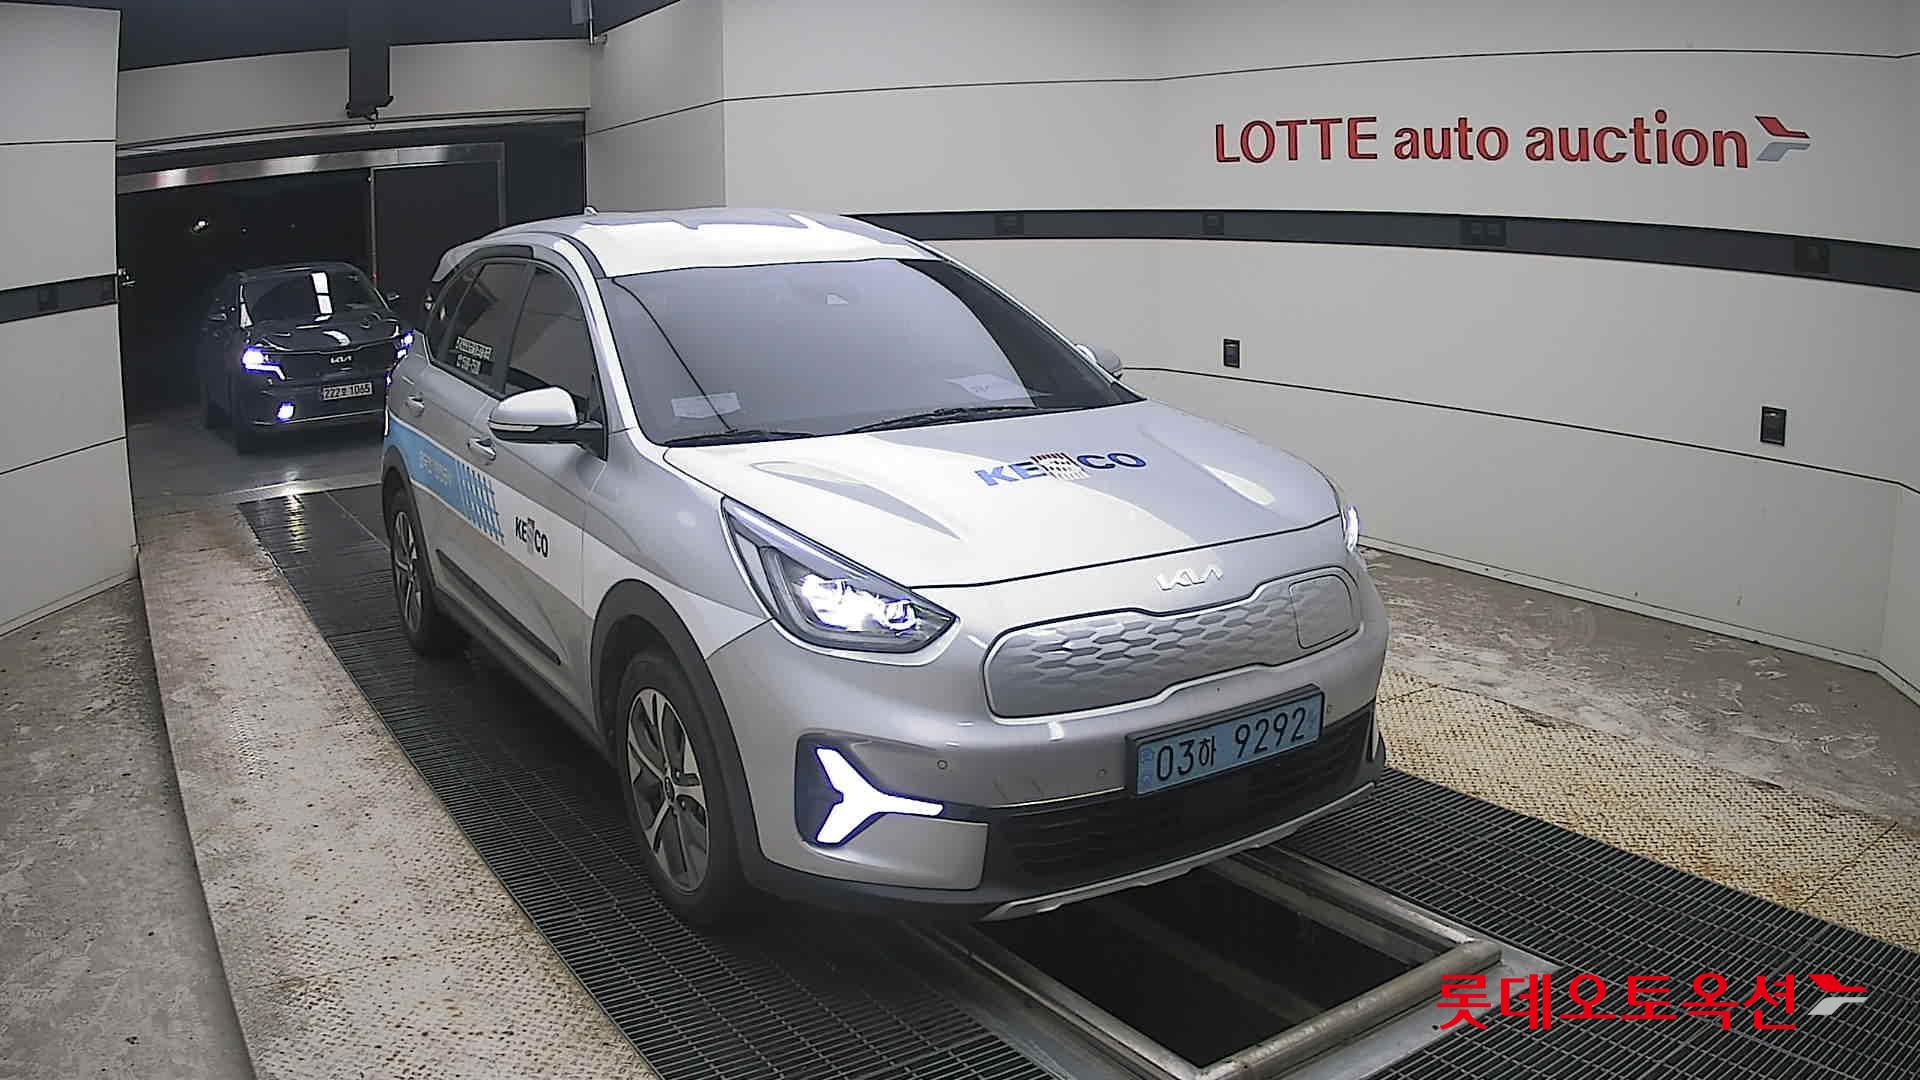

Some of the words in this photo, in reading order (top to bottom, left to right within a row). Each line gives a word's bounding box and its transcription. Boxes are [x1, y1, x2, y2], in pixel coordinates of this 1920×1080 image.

[1215, 116, 1378, 163] LOTTE
[1393, 117, 1509, 161] auto
[1525, 109, 1748, 168] auction
[974, 451, 1147, 486] KECO
[515, 516, 549, 558] KECO
[1156, 736, 1216, 781] 03하
[1234, 707, 1306, 759] 9292
